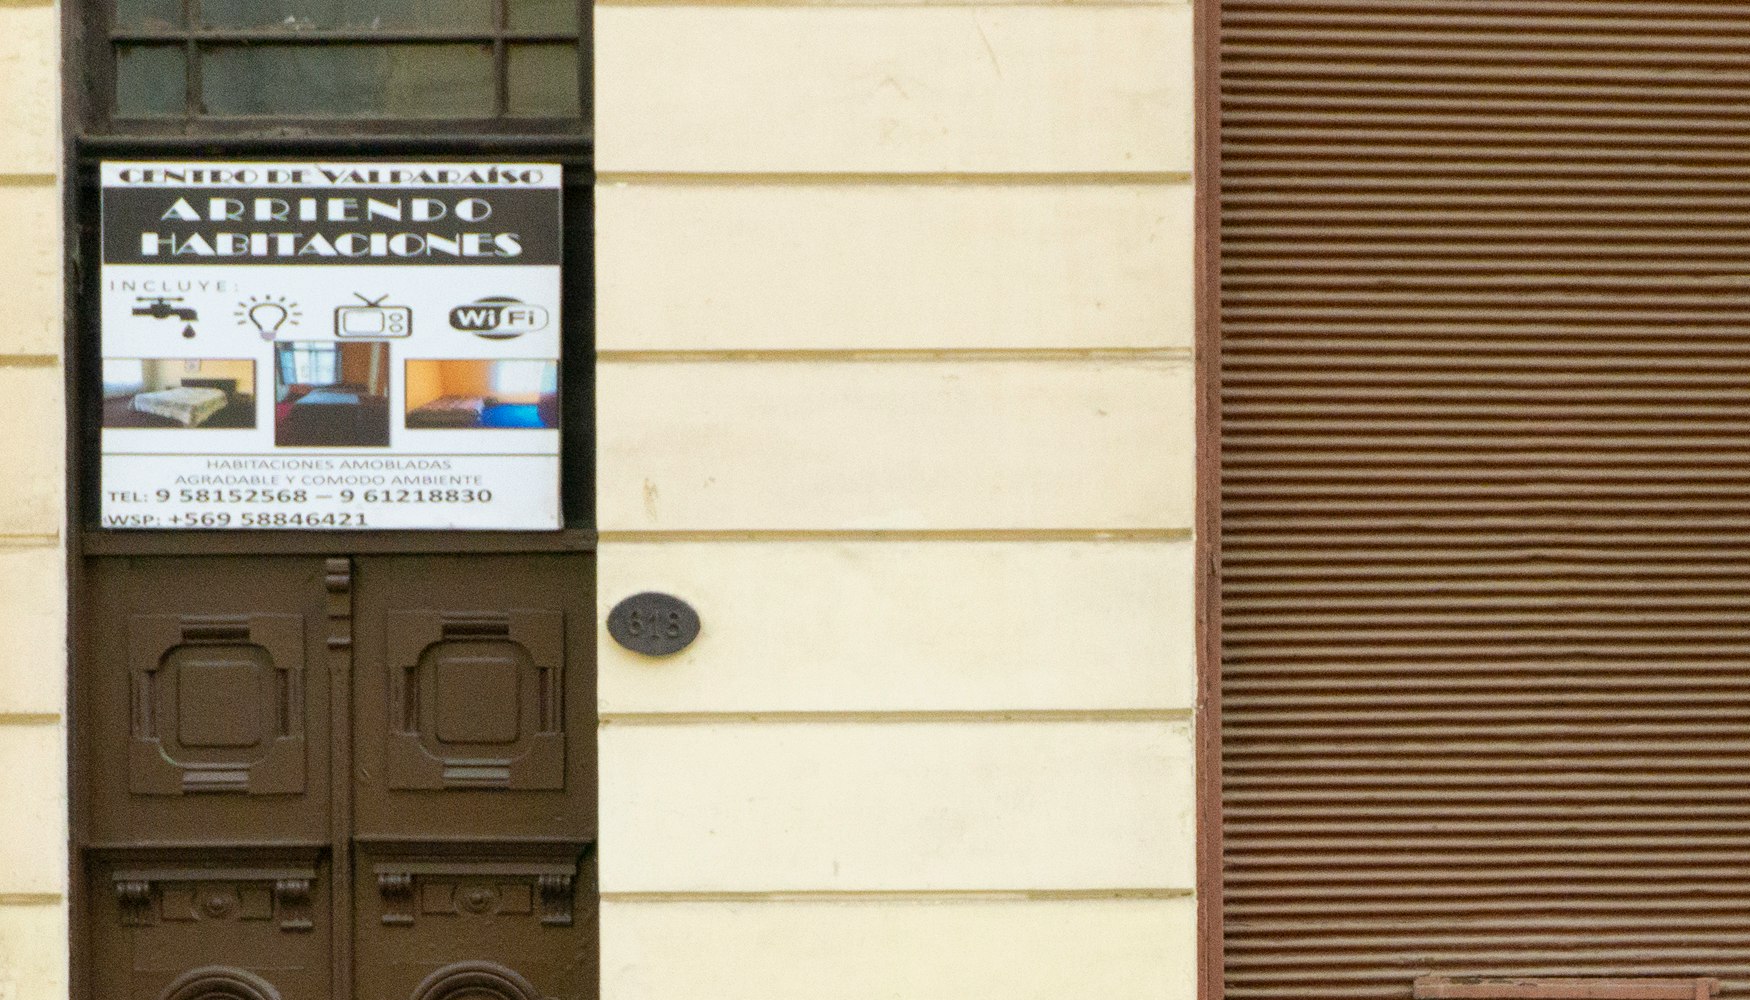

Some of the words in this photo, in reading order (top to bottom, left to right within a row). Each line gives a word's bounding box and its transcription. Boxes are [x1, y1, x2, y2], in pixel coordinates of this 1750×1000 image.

[119, 169, 258, 184] CENTRO
[267, 169, 312, 184] DE
[315, 166, 543, 184] VALPARAÍSO
[161, 197, 493, 222] ARRIENDO
[141, 231, 523, 257] HABITACIONES
[110, 280, 239, 291] INCLUYE:
[206, 459, 334, 470] HABITACIONES
[339, 459, 452, 470] AMOBLADAS
[175, 475, 279, 485] AGRADABLE
[286, 475, 296, 485] Y
[300, 475, 385, 485] COMODO
[391, 475, 483, 486] AMBIENTE
[108, 491, 148, 502] TEL:
[155, 489, 171, 503] 9
[179, 489, 308, 503] 58152568
[340, 489, 355, 503] 9
[363, 489, 493, 504] 61218830
[108, 514, 161, 527] WSP:
[168, 512, 231, 527] +569
[241, 512, 369, 527] 58846421
